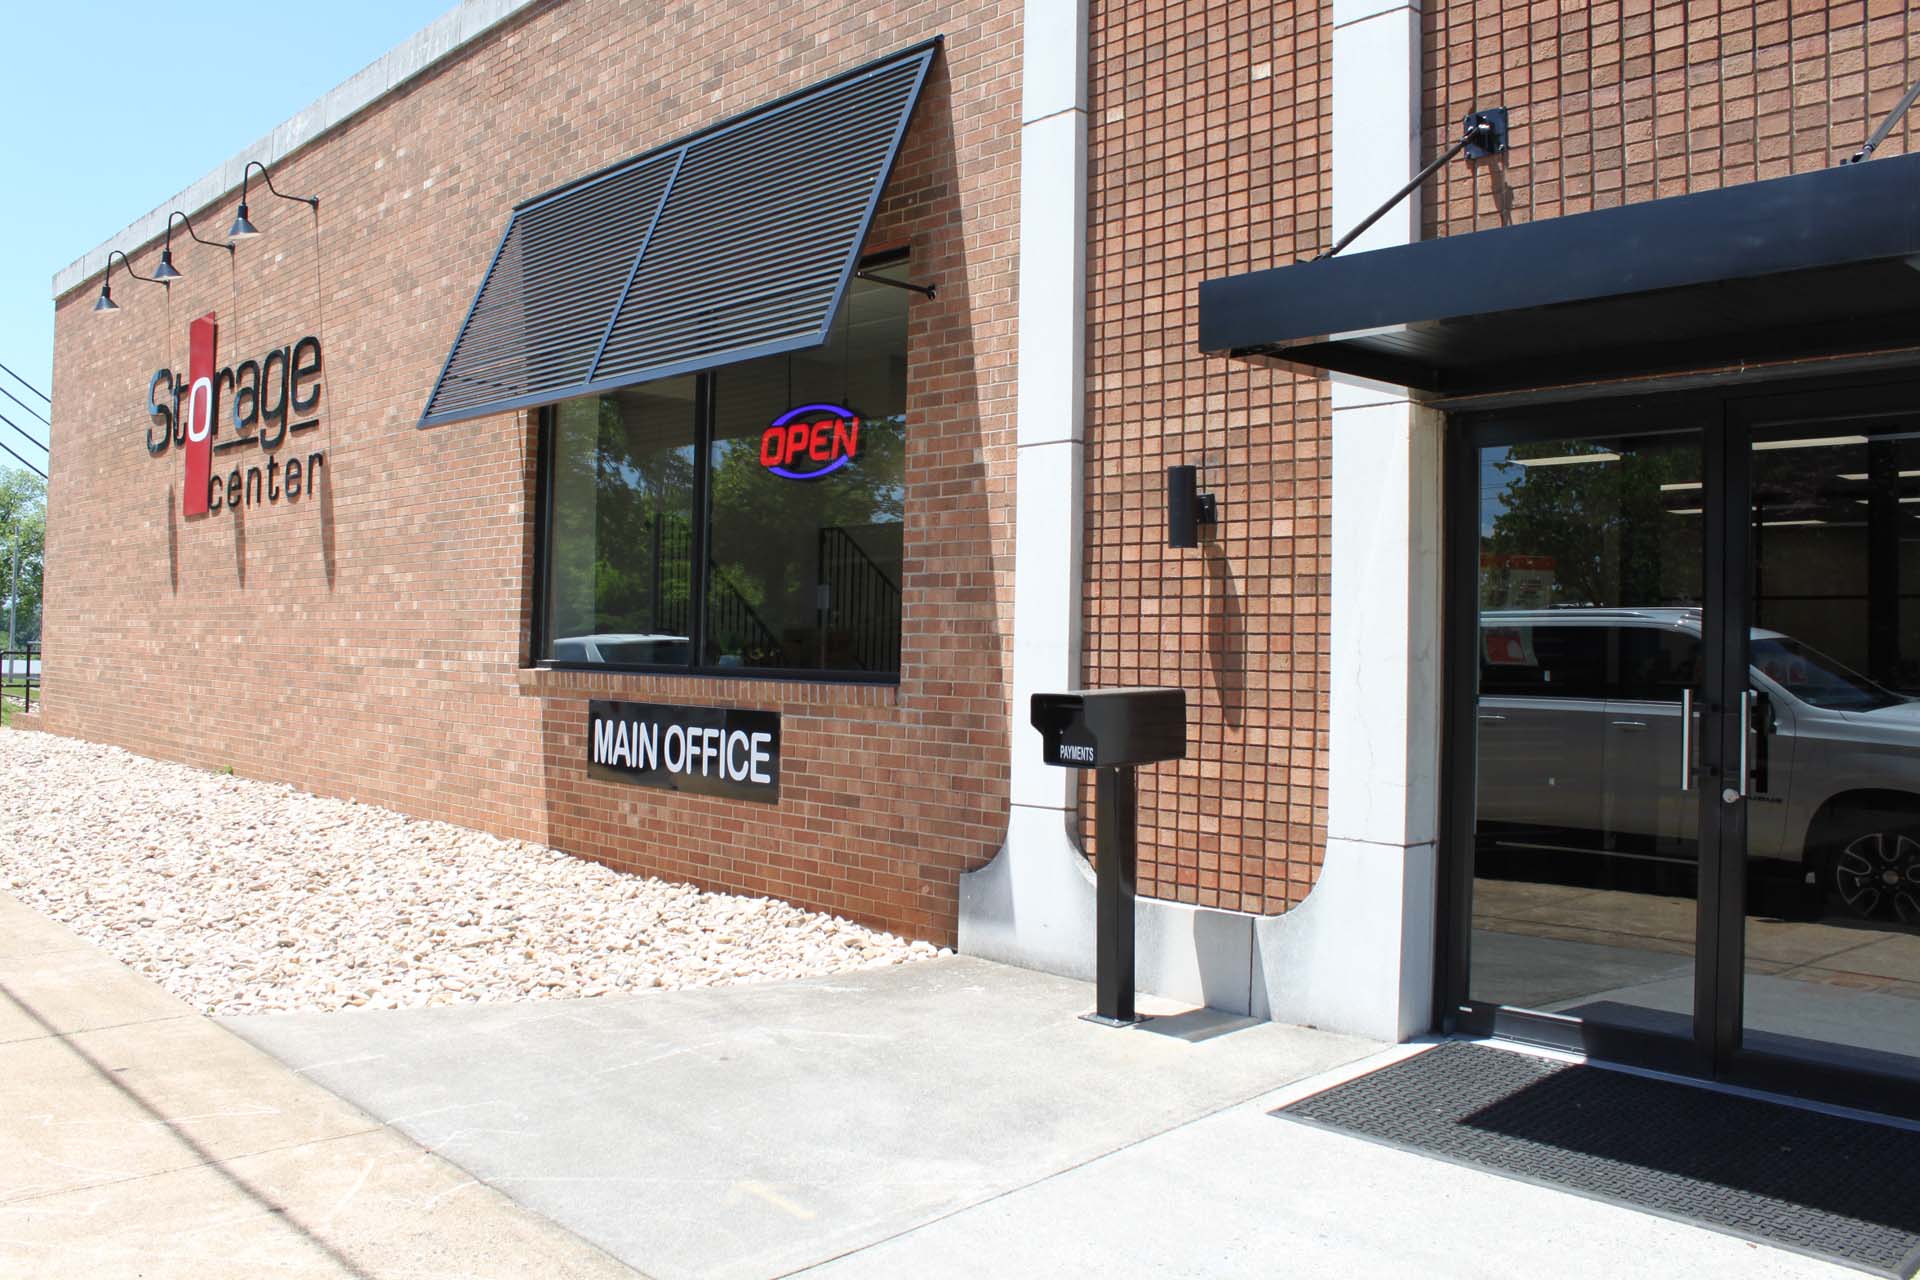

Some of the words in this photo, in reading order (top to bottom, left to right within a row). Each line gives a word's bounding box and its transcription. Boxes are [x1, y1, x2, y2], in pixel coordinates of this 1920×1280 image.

[147, 336, 322, 454] Storage
[760, 416, 860, 467] OPEN
[208, 452, 323, 510] center
[593, 718, 658, 771] MAIN
[664, 724, 771, 784] OFFICE
[1060, 744, 1094, 761] PAYMENTS
